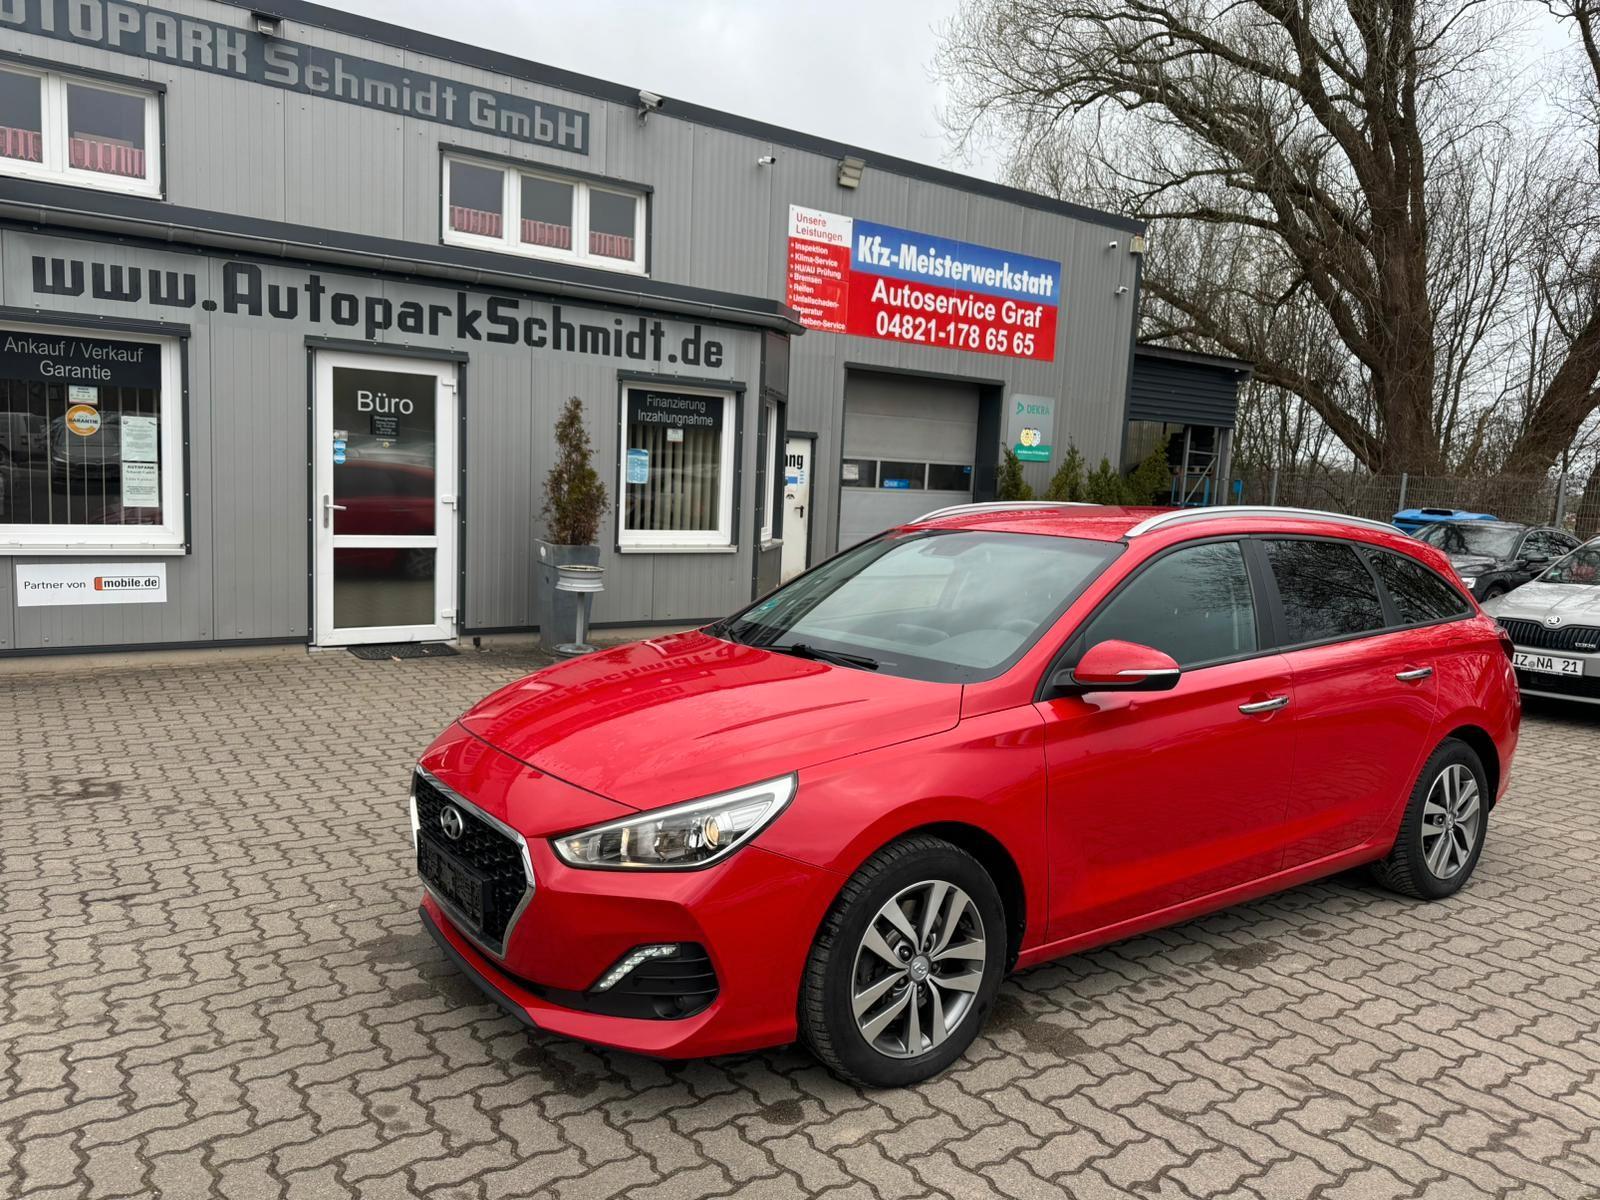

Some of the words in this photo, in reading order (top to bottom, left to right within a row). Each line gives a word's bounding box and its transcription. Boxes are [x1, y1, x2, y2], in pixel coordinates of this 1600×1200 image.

[263, 42, 457, 121] Schmidt
[469, 90, 583, 150] GmbH
[796, 213, 827, 227] Unsere
[795, 224, 843, 242] Leistungen
[795, 241, 828, 255] Inspektion
[795, 253, 838, 267] Klima-Service
[857, 235, 1053, 297] Kfz-Meisterwerkstatt
[794, 263, 815, 275] HU/AU
[816, 267, 841, 280] Prüfung
[794, 272, 822, 285] Bremsen
[793, 283, 814, 294] Reifen
[32, 255, 723, 368] www.AutoparkSchmidt.de
[871, 278, 996, 321] Autoservice
[1001, 300, 1043, 328] Graf
[876, 311, 980, 349] 04821-178
[985, 328, 1008, 352] 65
[1012, 332, 1035, 356] 65
[4, 336, 66, 357] Ankauf
[69, 342, 76, 358] /
[80, 343, 144, 363] Verkauf
[40, 360, 112, 381] Garantie
[357, 390, 414, 415] Büro
[646, 394, 706, 414] Finanzierung
[1027, 404, 1050, 416] DEKRA
[638, 409, 713, 427] Inzahlungnahme
[24, 581, 64, 590] Partner
[66, 581, 86, 589] von
[103, 577, 157, 588] mobile.de
[1513, 654, 1528, 666] IZ
[1536, 656, 1553, 670] NA
[1562, 660, 1578, 673] 21
